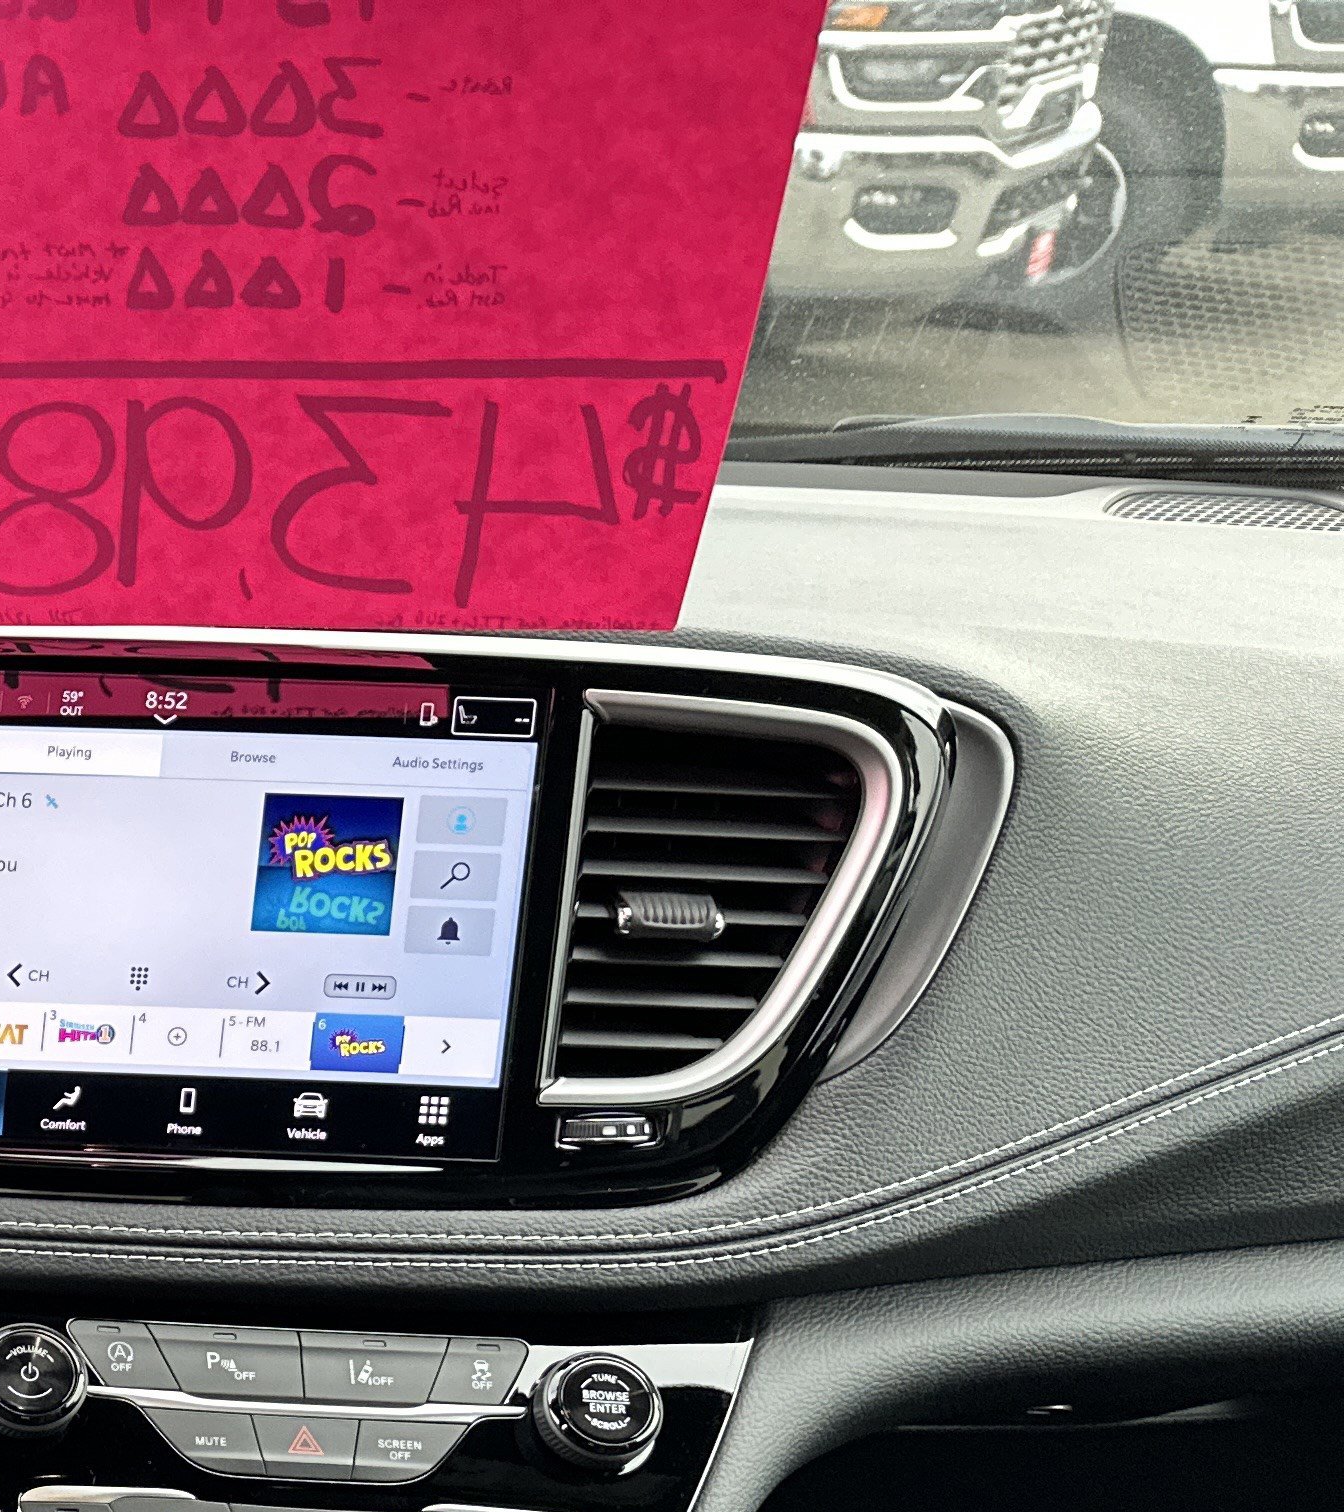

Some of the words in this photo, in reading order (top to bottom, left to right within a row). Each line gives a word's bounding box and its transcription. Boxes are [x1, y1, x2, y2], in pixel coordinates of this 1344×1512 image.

[146, 691, 188, 710] 8:52
[59, 706, 84, 717] OUT
[47, 745, 92, 761] Playing
[230, 750, 276, 764] Browse
[392, 756, 429, 770] Audio
[431, 757, 484, 773] Settings
[21, 793, 33, 809] 6
[283, 830, 317, 855] POP
[294, 843, 391, 878] ROCKS
[28, 968, 50, 982] CH
[226, 975, 250, 989] CH
[49, 1009, 57, 1021] 3
[138, 1012, 147, 1024] 4
[246, 1016, 266, 1029] FM
[318, 1018, 327, 1030] 6
[250, 1039, 281, 1053] 88.1
[340, 1041, 386, 1057] ROCKS
[40, 1119, 86, 1131] Comfort
[166, 1123, 202, 1136] Phone
[286, 1127, 327, 1141] Vehicle
[415, 1134, 445, 1147] Apps
[10, 1343, 49, 1358] VOLUME
[110, 1362, 132, 1373] OFF
[234, 1371, 256, 1381] OFF
[373, 1376, 394, 1387] OFF
[591, 1373, 619, 1385] TUNE
[471, 1380, 493, 1391] OFF
[582, 1389, 630, 1402] BROWSE
[588, 1402, 627, 1415] ENTER
[590, 1416, 630, 1432] SCROLL
[195, 1436, 227, 1447] MUTE
[377, 1438, 423, 1452] SCREEN
[389, 1450, 411, 1461] OFF
